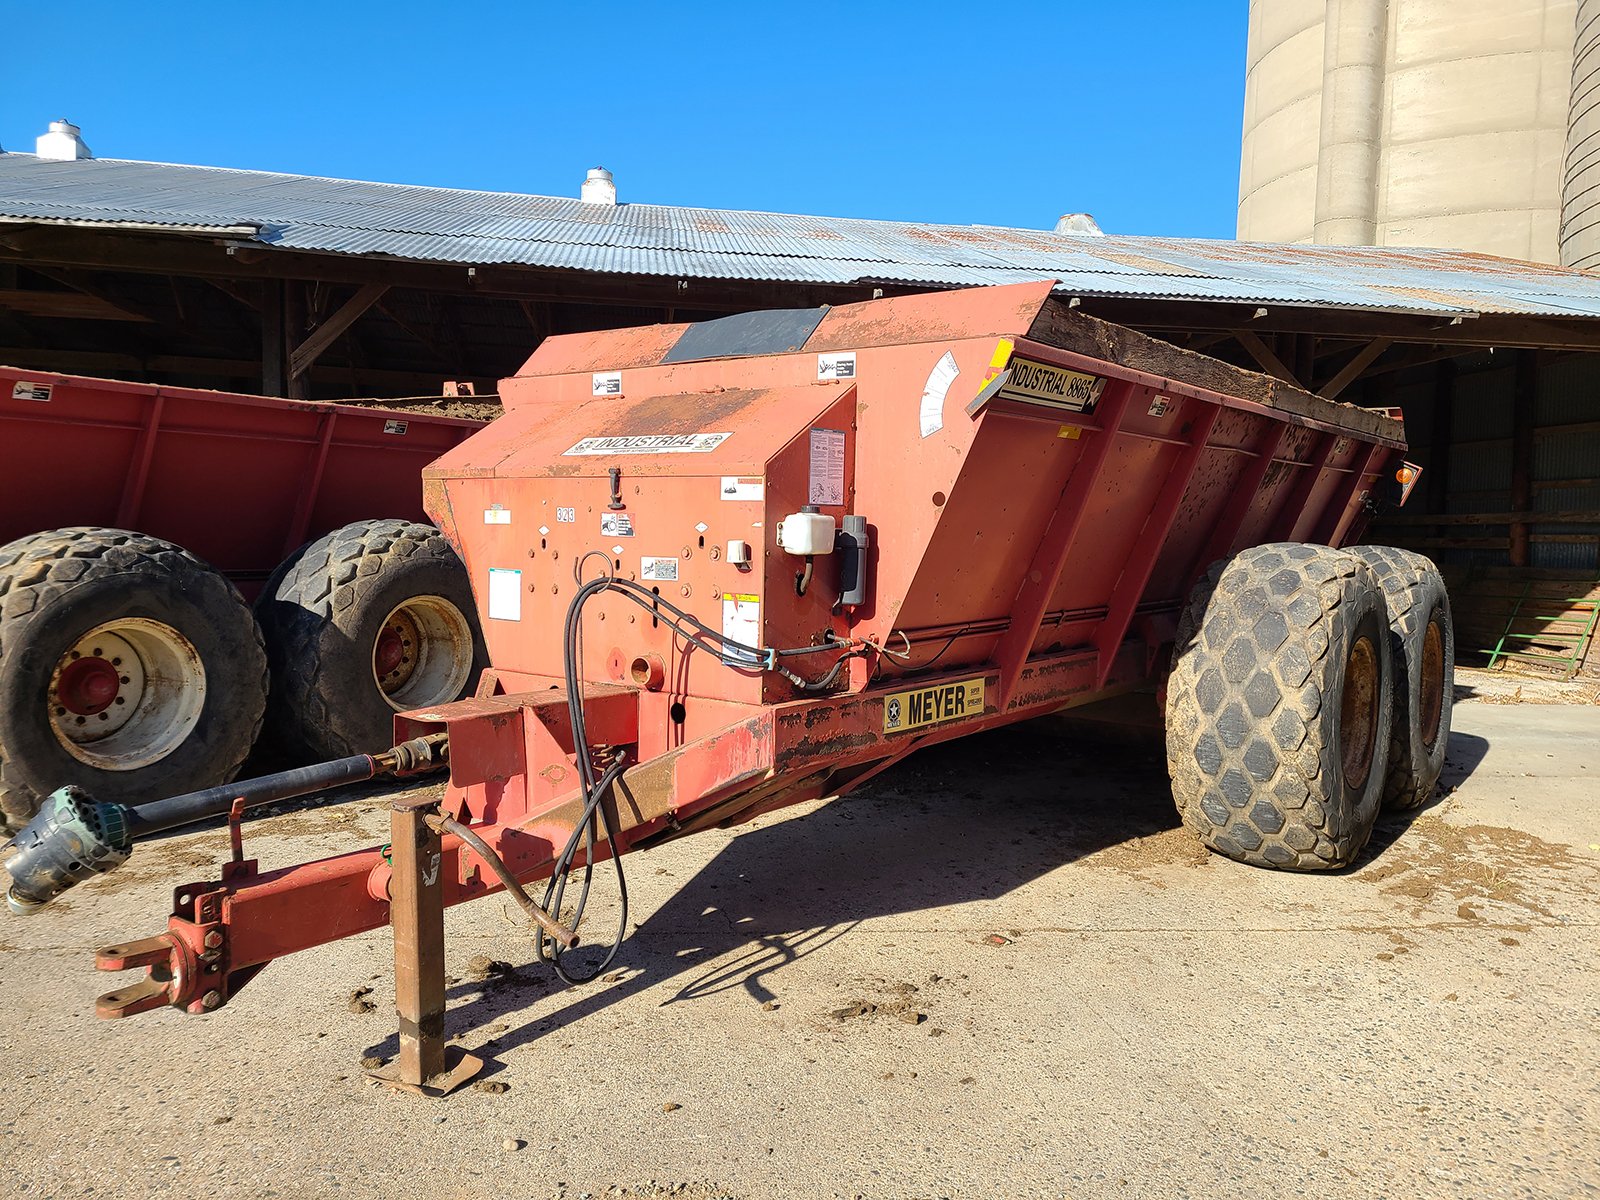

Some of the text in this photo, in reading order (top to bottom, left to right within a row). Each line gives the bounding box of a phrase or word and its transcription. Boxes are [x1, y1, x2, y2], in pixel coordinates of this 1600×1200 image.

[1006, 362, 1092, 400] INDUSTRIAL 8865
[595, 434, 698, 448] INDUSTRIAL
[557, 508, 574, 521] 323
[908, 685, 965, 726] MEYER
